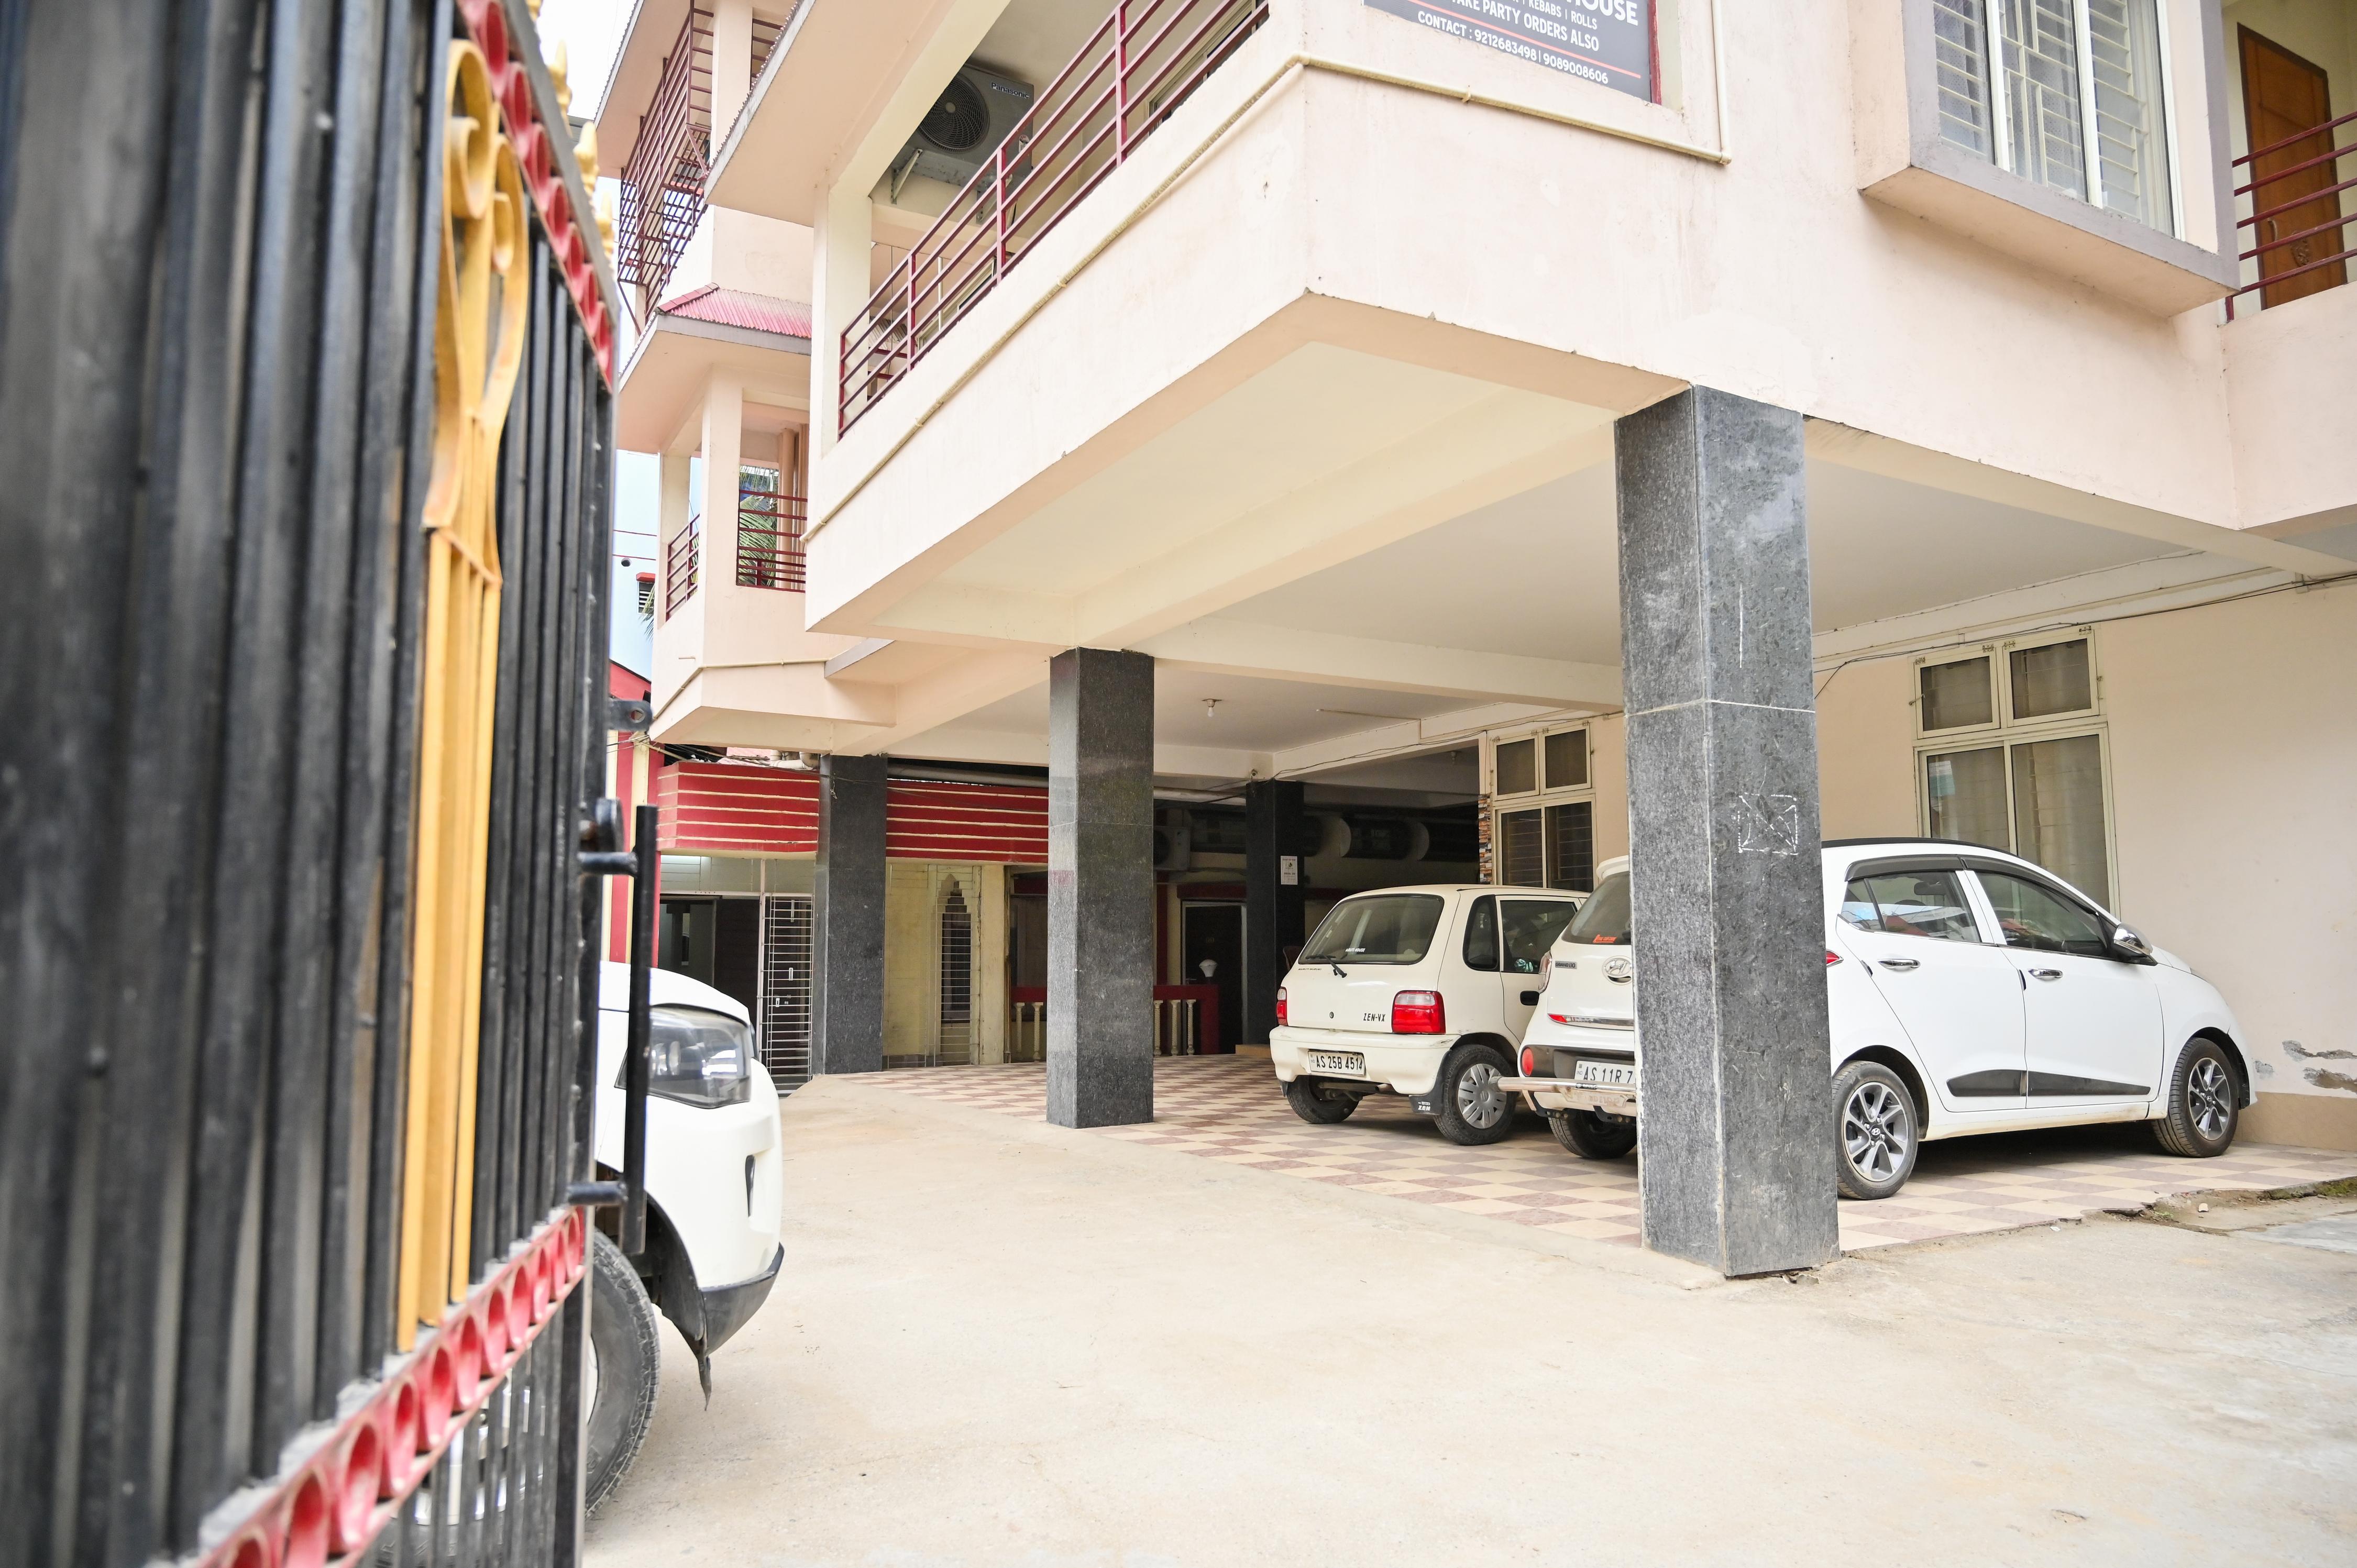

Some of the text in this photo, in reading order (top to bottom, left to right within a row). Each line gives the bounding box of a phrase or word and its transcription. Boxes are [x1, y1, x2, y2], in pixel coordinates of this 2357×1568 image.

[1529, 0, 1562, 17] KEBABS
[1571, 10, 1598, 30] ROLLS
[1567, 0, 1638, 26] USE
[1483, 0, 1521, 24] PARTY
[1524, 13, 1567, 41] ORDERS
[1570, 29, 1599, 51] ALSO
[1417, 11, 1467, 37] CONTACT
[1474, 29, 1537, 61] 9212683498
[1543, 53, 1609, 84] 9089008606
[992, 82, 1030, 98] Panasonic
[1363, 1013, 1385, 1022] ZEN-VX
[1316, 1055, 1362, 1070] AS 25B 4514
[1583, 1066, 1597, 1080] AS
[1602, 1068, 1622, 1083] 11R
